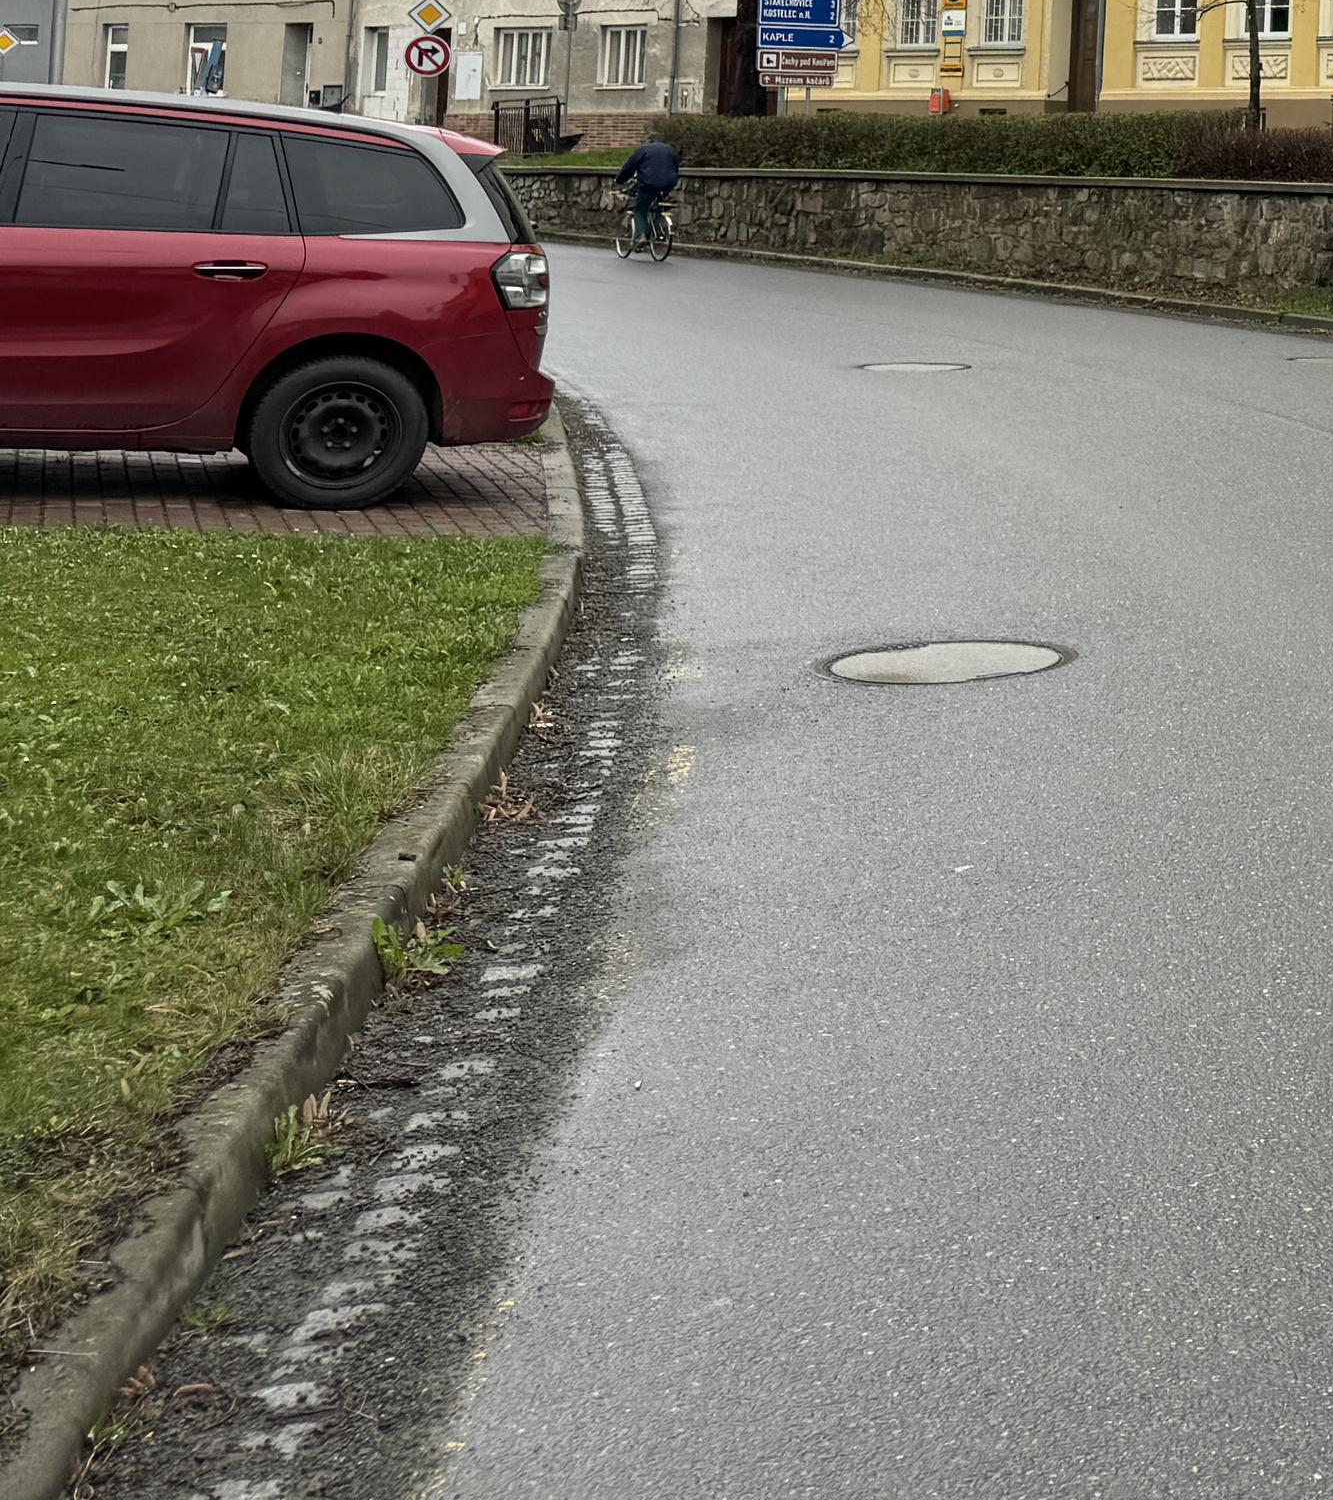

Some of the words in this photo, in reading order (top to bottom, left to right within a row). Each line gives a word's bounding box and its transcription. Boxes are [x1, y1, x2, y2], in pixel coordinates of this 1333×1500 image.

[830, 0, 835, 8] 3
[763, 8, 797, 19] KOSTELEC
[830, 12, 835, 20] 2
[762, 32, 794, 42] KAPLE
[829, 35, 835, 44] 2
[799, 57, 811, 66] pod
